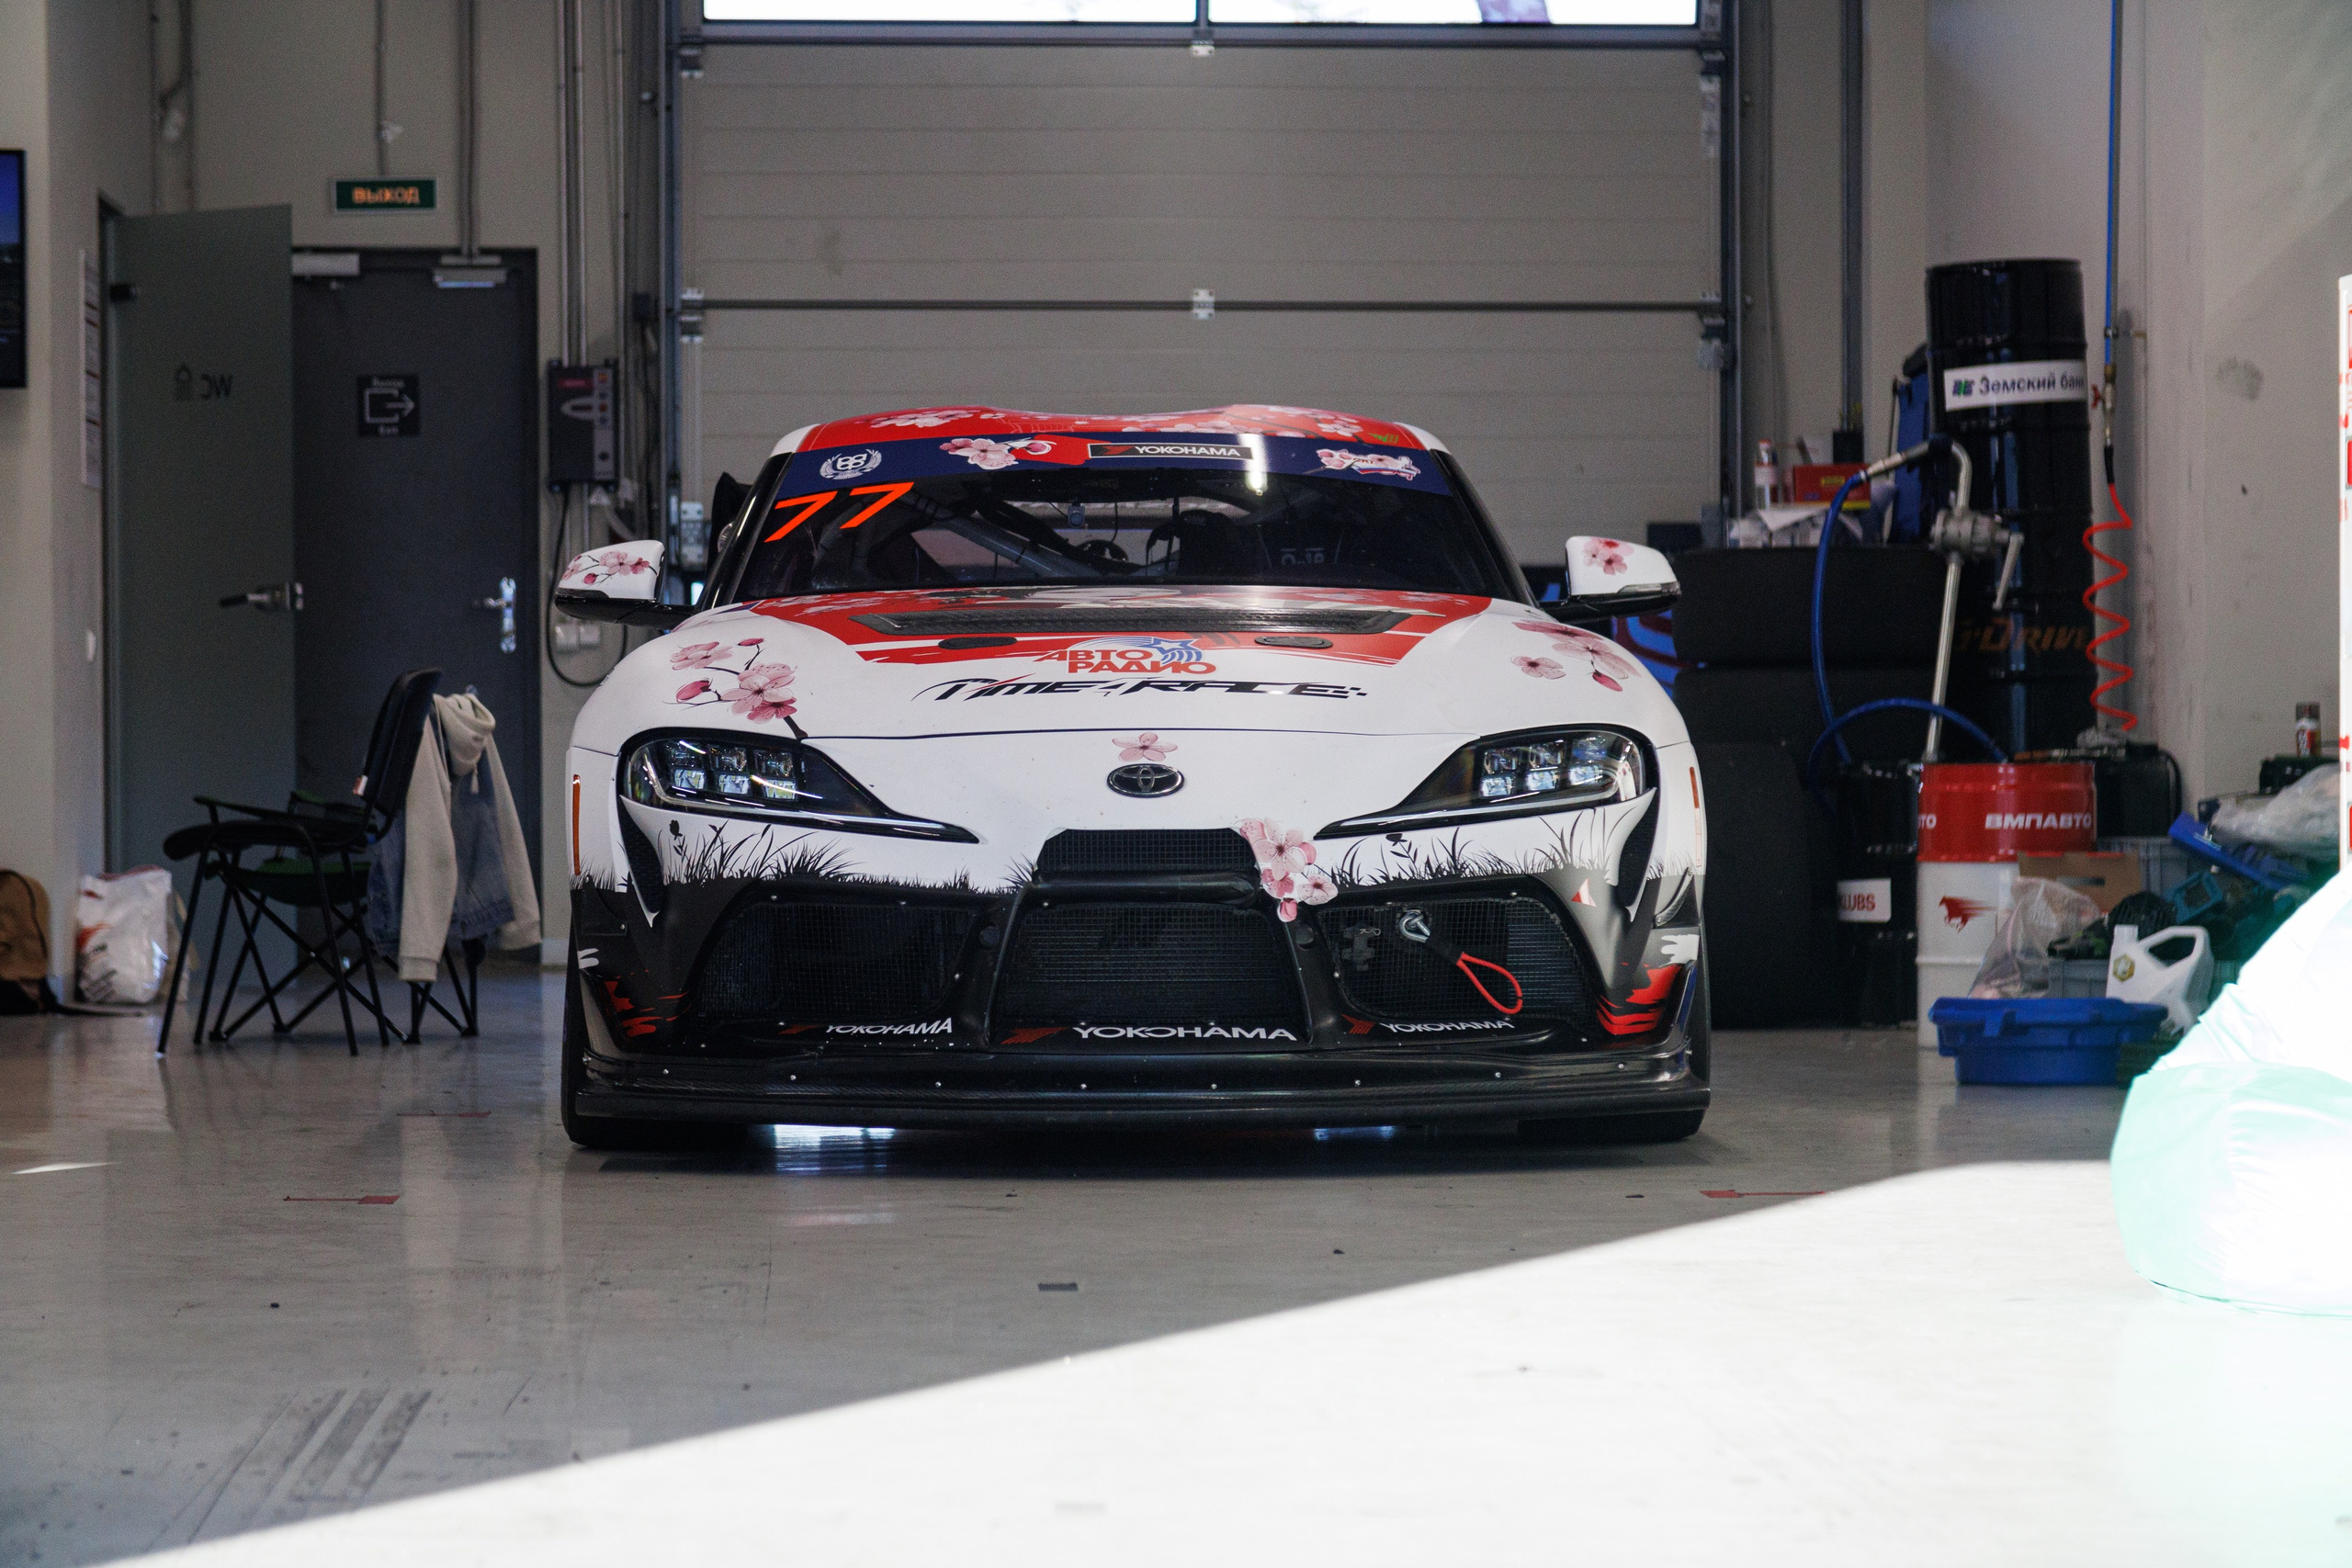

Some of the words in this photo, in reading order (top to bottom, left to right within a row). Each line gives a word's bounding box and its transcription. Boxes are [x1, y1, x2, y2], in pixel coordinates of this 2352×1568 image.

[353, 186, 421, 205] ВЫХОД
[1980, 372, 2056, 395] Земский
[1135, 446, 1241, 457] YOKOHAMA
[764, 482, 914, 543] 77
[1033, 649, 1153, 662] АВТО
[1068, 660, 1216, 675] РАДИО
[1984, 812, 2093, 830] ВМПАВТО
[826, 1017, 953, 1035] YOKOHAMA
[1072, 1025, 1297, 1042] YOKOHAMA
[1379, 1020, 1515, 1033] YOKOHAMA
